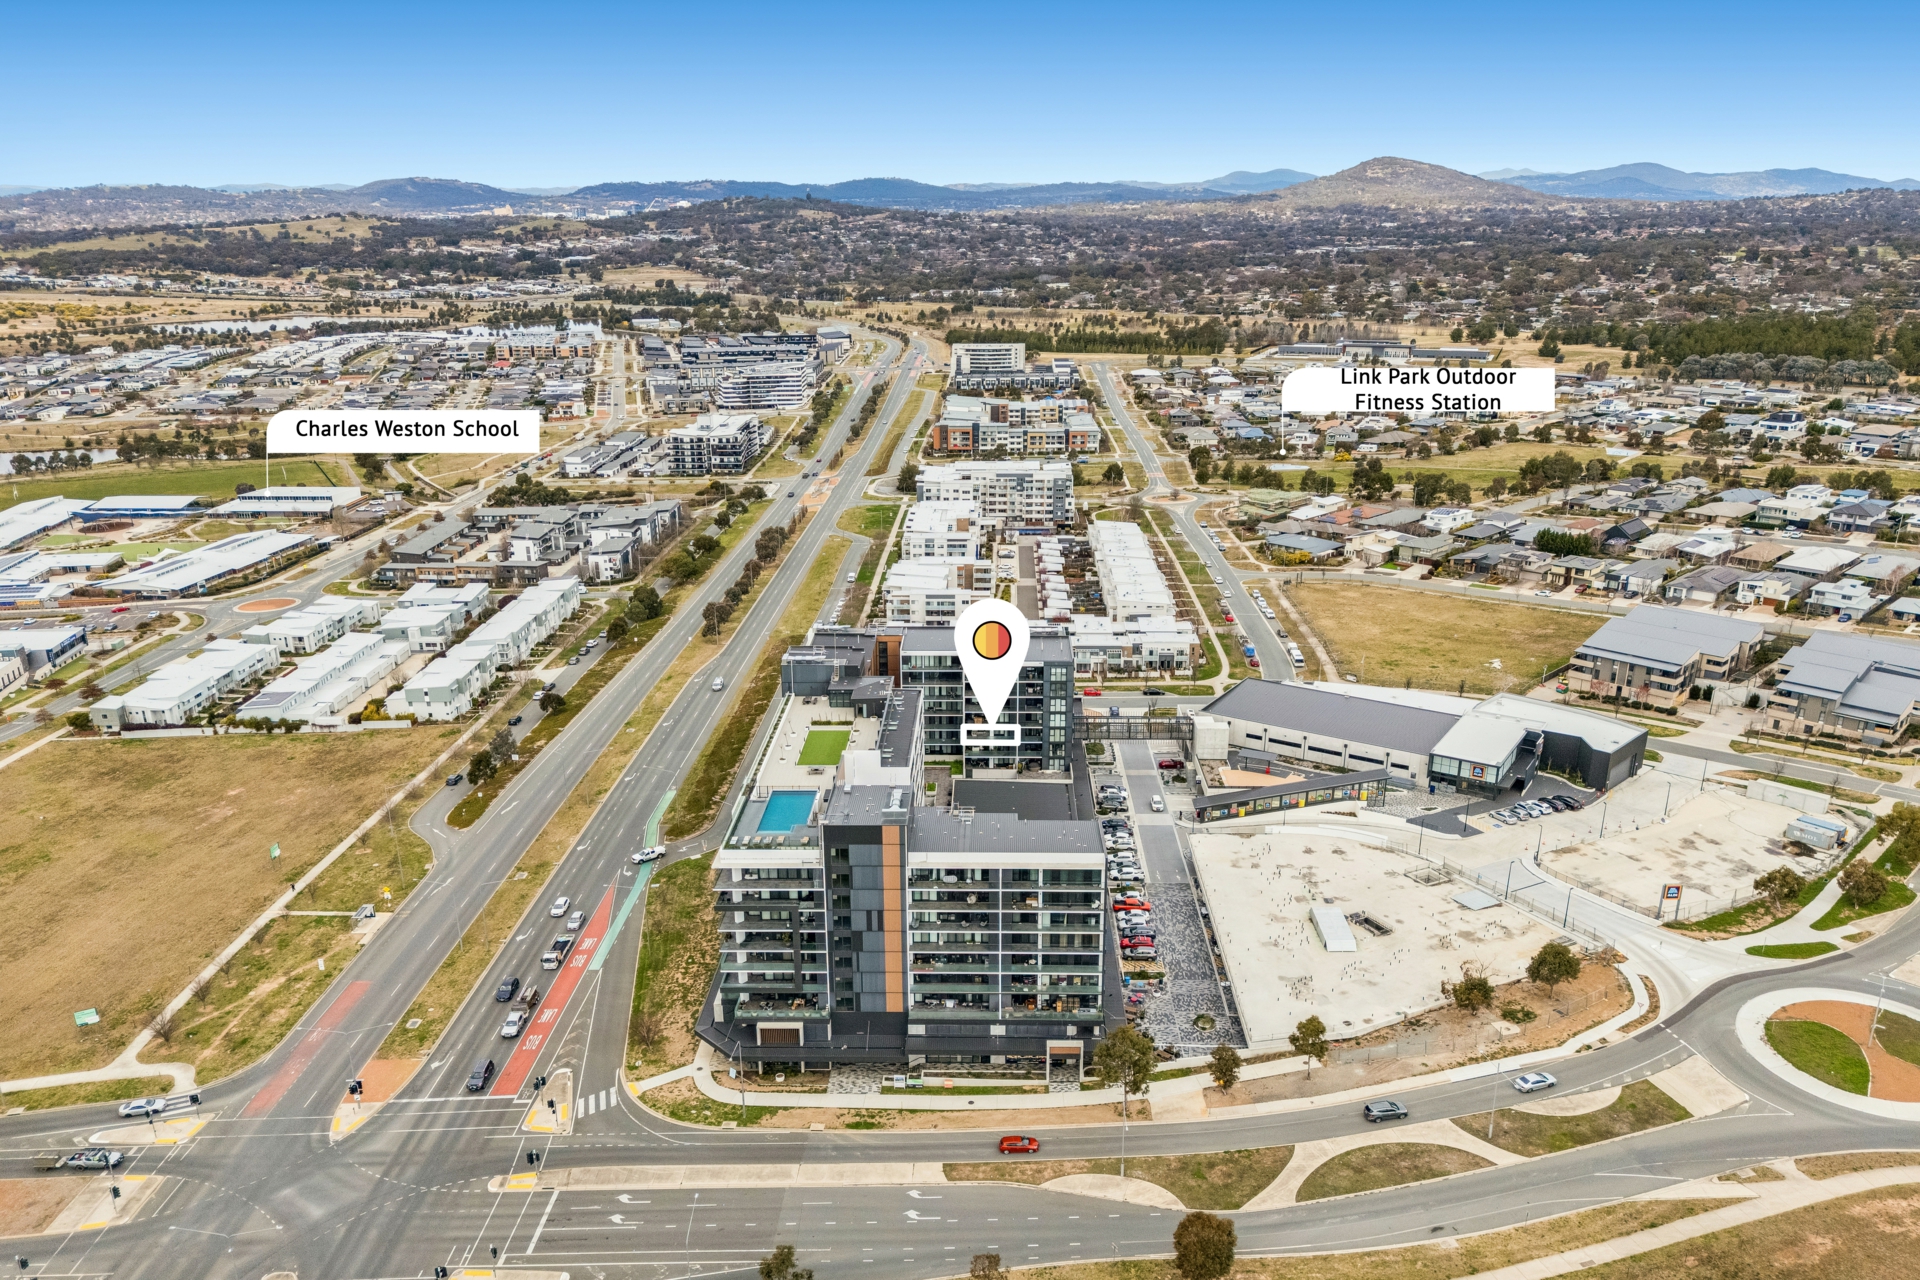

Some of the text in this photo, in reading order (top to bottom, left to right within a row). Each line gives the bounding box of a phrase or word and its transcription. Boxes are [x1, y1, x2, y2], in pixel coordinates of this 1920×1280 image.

[1801, 833, 1819, 842] MOL
[579, 937, 598, 950] LANE
[570, 954, 588, 967] BUS
[537, 1008, 558, 1023] LANE
[522, 1034, 543, 1050] BUS
